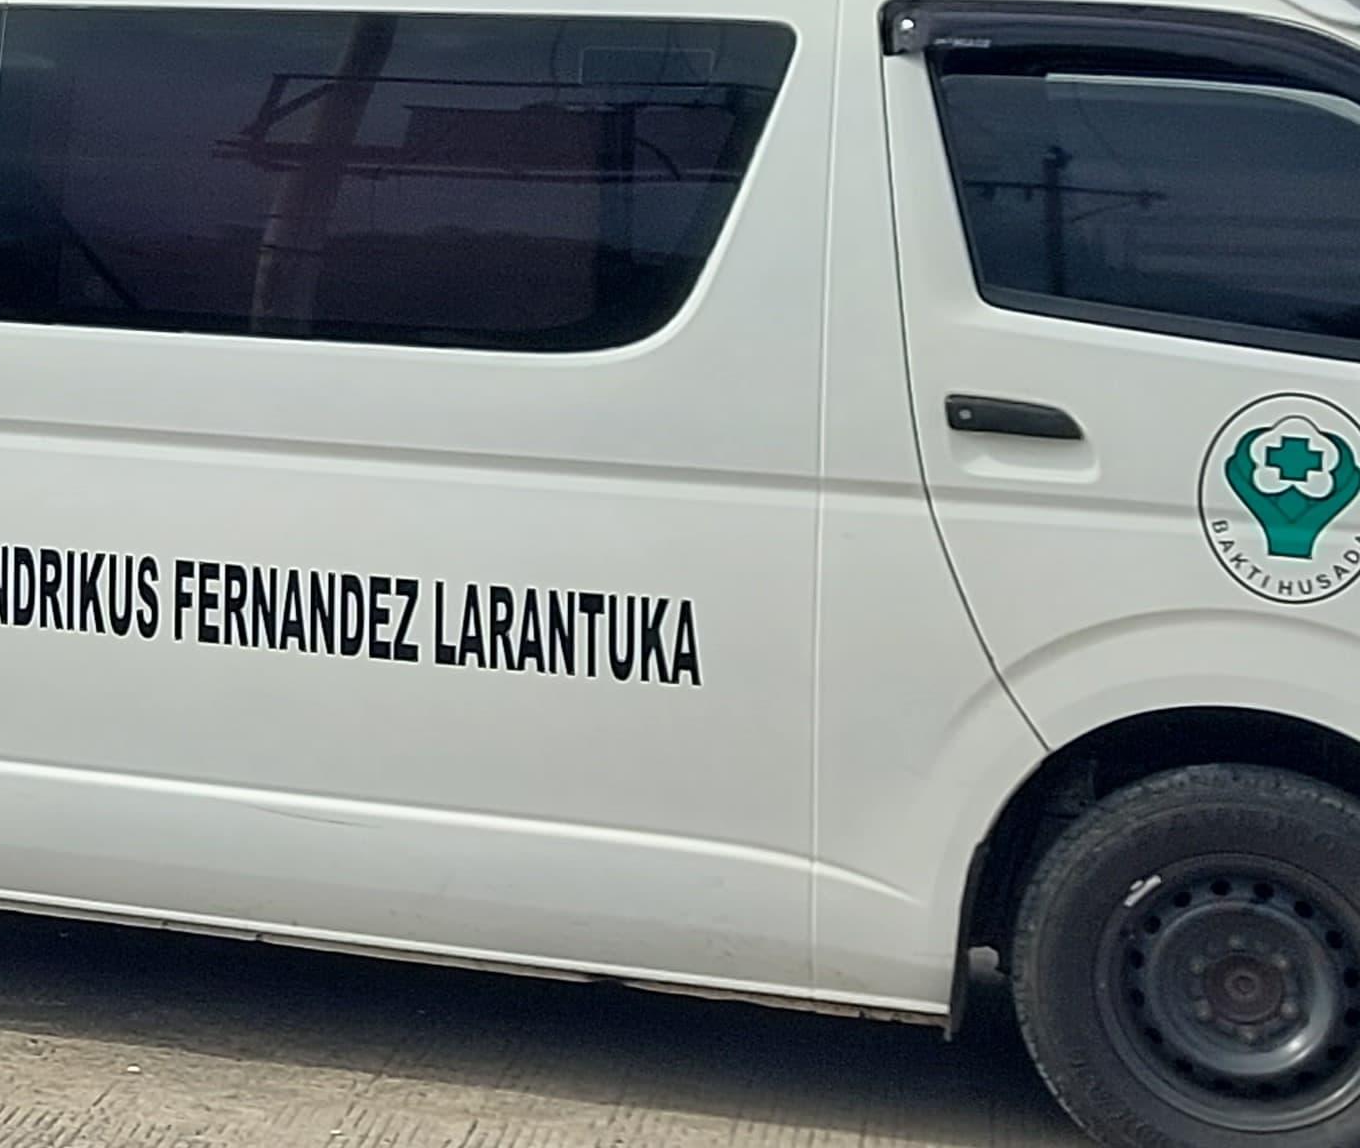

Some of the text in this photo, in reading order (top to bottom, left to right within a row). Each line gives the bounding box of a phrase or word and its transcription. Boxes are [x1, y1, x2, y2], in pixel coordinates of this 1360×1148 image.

[1211, 518, 1360, 596] BAKTI HUSAD
[173, 558, 420, 664] FERNANDEZ
[433, 580, 702, 687] LARANTUKA
